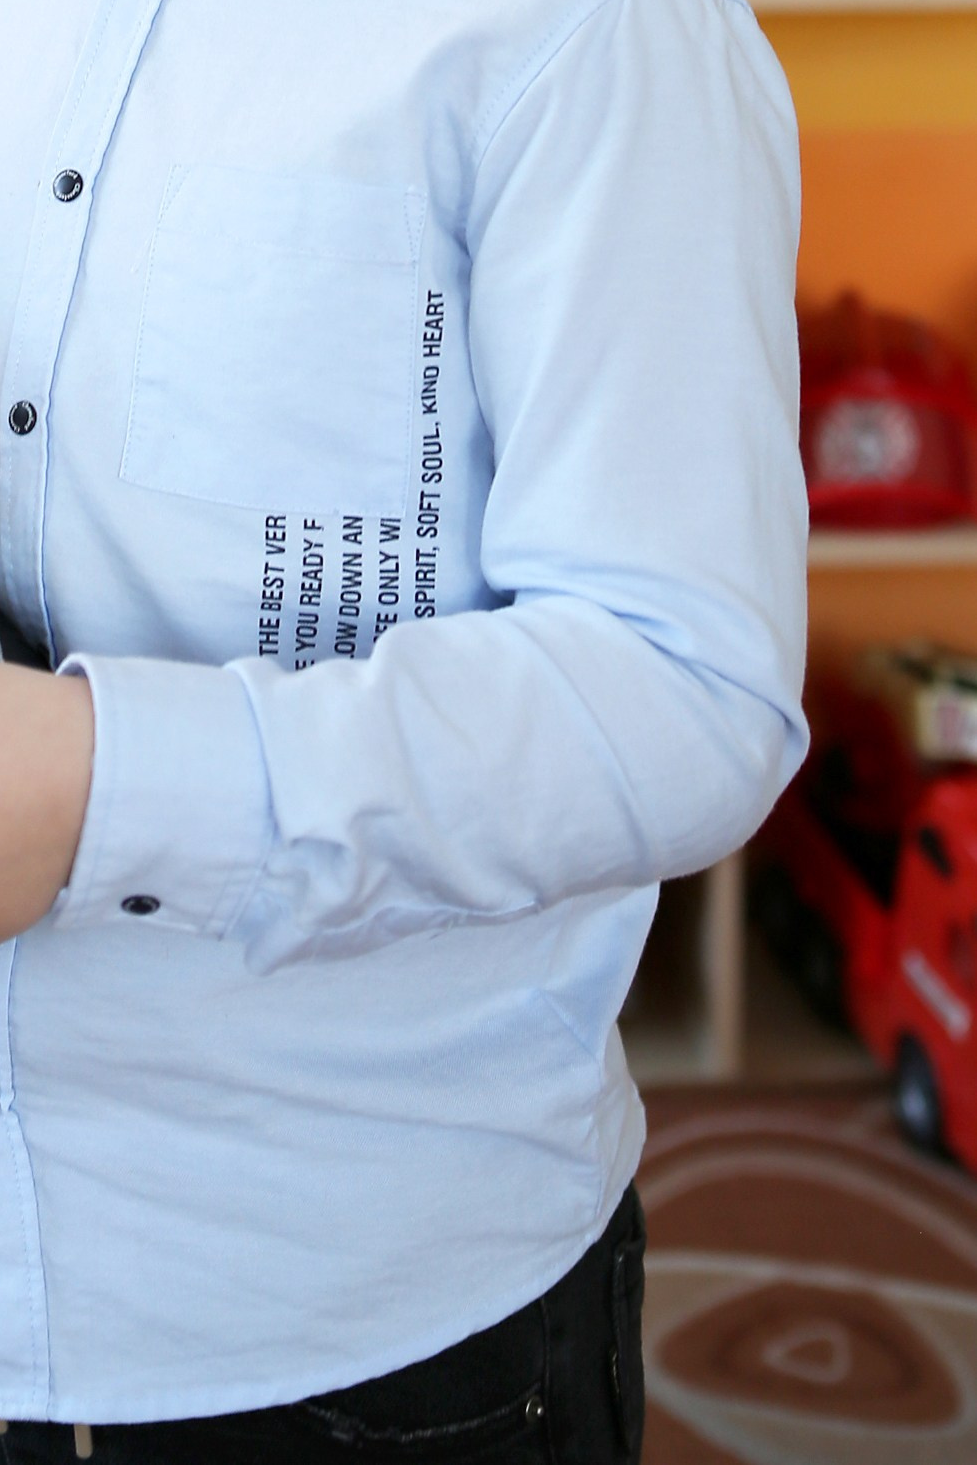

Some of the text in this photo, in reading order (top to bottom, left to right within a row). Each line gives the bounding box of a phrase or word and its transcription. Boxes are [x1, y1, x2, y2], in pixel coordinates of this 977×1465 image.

[422, 290, 445, 357] HEART
[421, 365, 440, 414] KIND
[379, 518, 401, 543] WI
[416, 490, 441, 539] SOFT
[259, 515, 286, 656] THE BEST VER
[300, 538, 323, 606] READY
[334, 515, 363, 659] OW DOWN AN
[378, 551, 399, 606] ONLY
[415, 547, 439, 618] SPIRIT,
[295, 612, 319, 652] YOU
